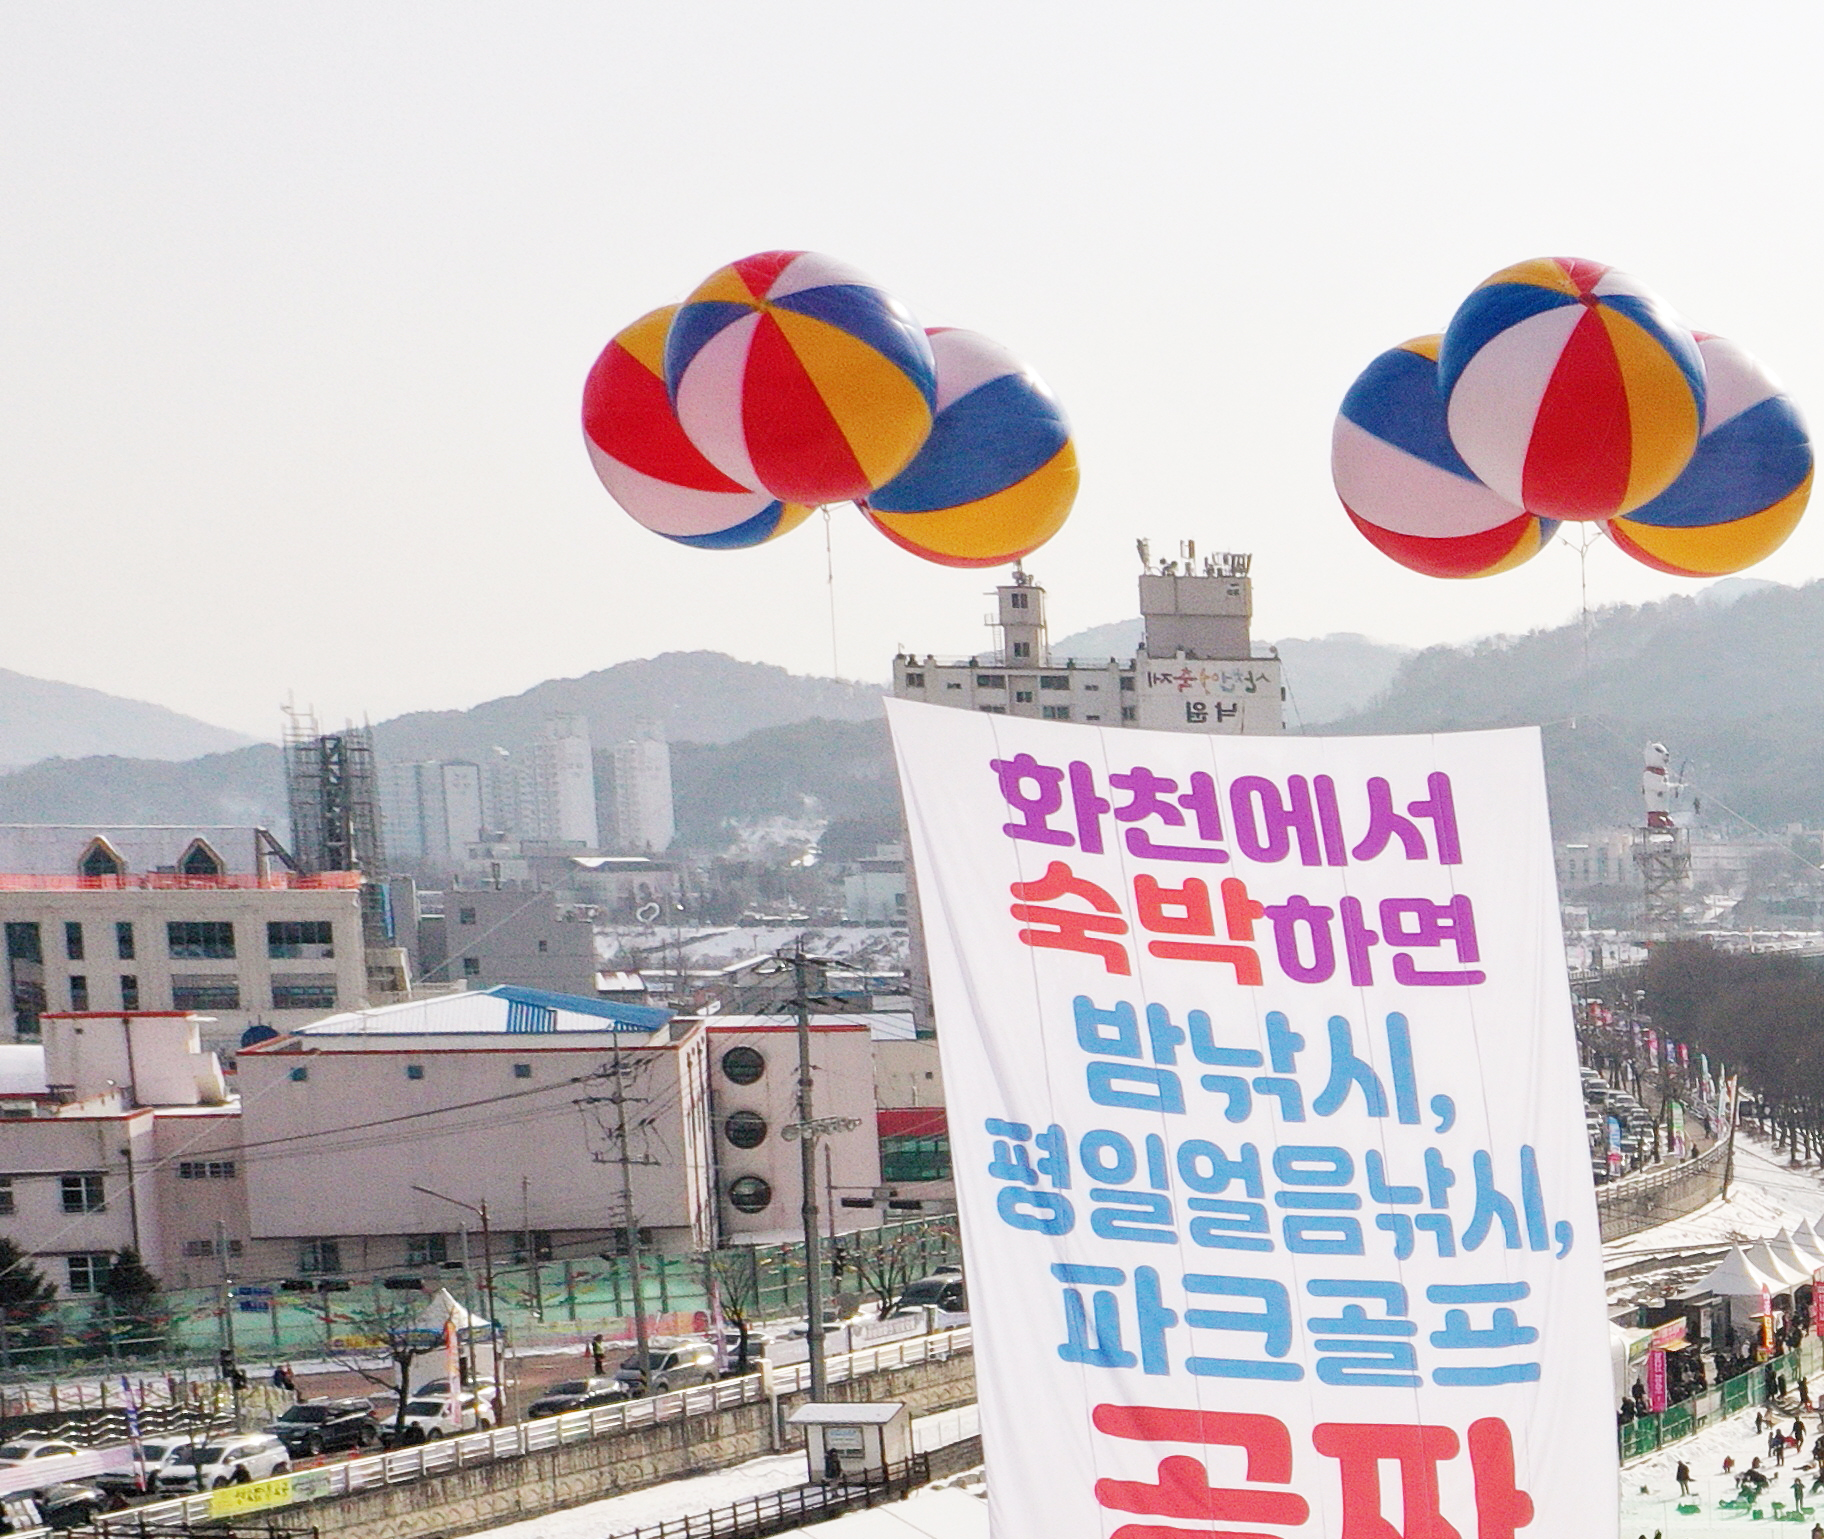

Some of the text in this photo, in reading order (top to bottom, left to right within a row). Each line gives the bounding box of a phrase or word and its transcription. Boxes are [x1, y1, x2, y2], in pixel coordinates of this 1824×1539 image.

[990, 752, 1462, 867] 화천에서
[1009, 861, 1487, 986] 숙박하면
[1073, 995, 1457, 1134] 밤낚시,
[984, 1117, 1575, 1260] 평일얼음낚시,
[1050, 1262, 1542, 1388] 파크골프
